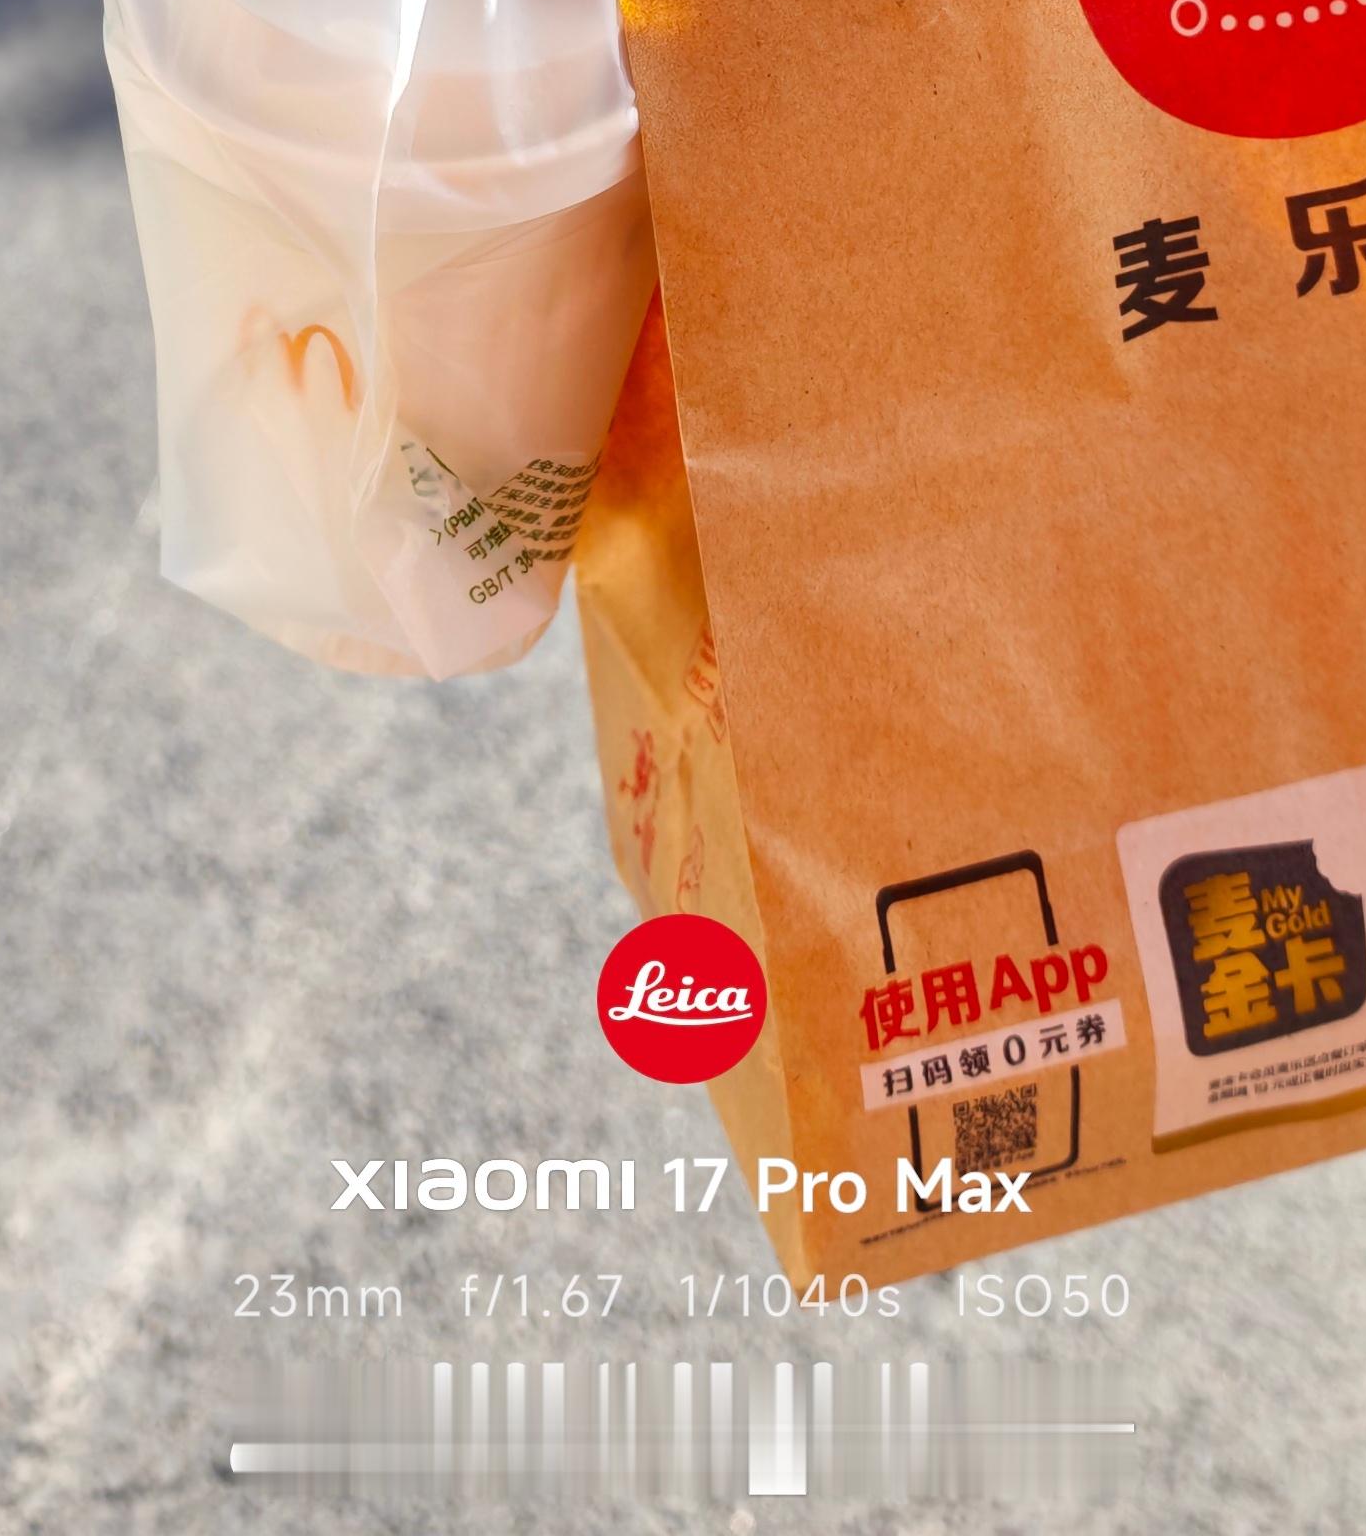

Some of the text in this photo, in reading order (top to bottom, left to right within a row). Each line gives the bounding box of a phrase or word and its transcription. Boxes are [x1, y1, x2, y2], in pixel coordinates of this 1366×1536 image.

[469, 565, 514, 604] GB/T
[1184, 871, 1267, 962] 麦
[1260, 884, 1304, 912] My
[1265, 900, 1331, 940] Gold
[1200, 936, 1346, 1039] 金卡
